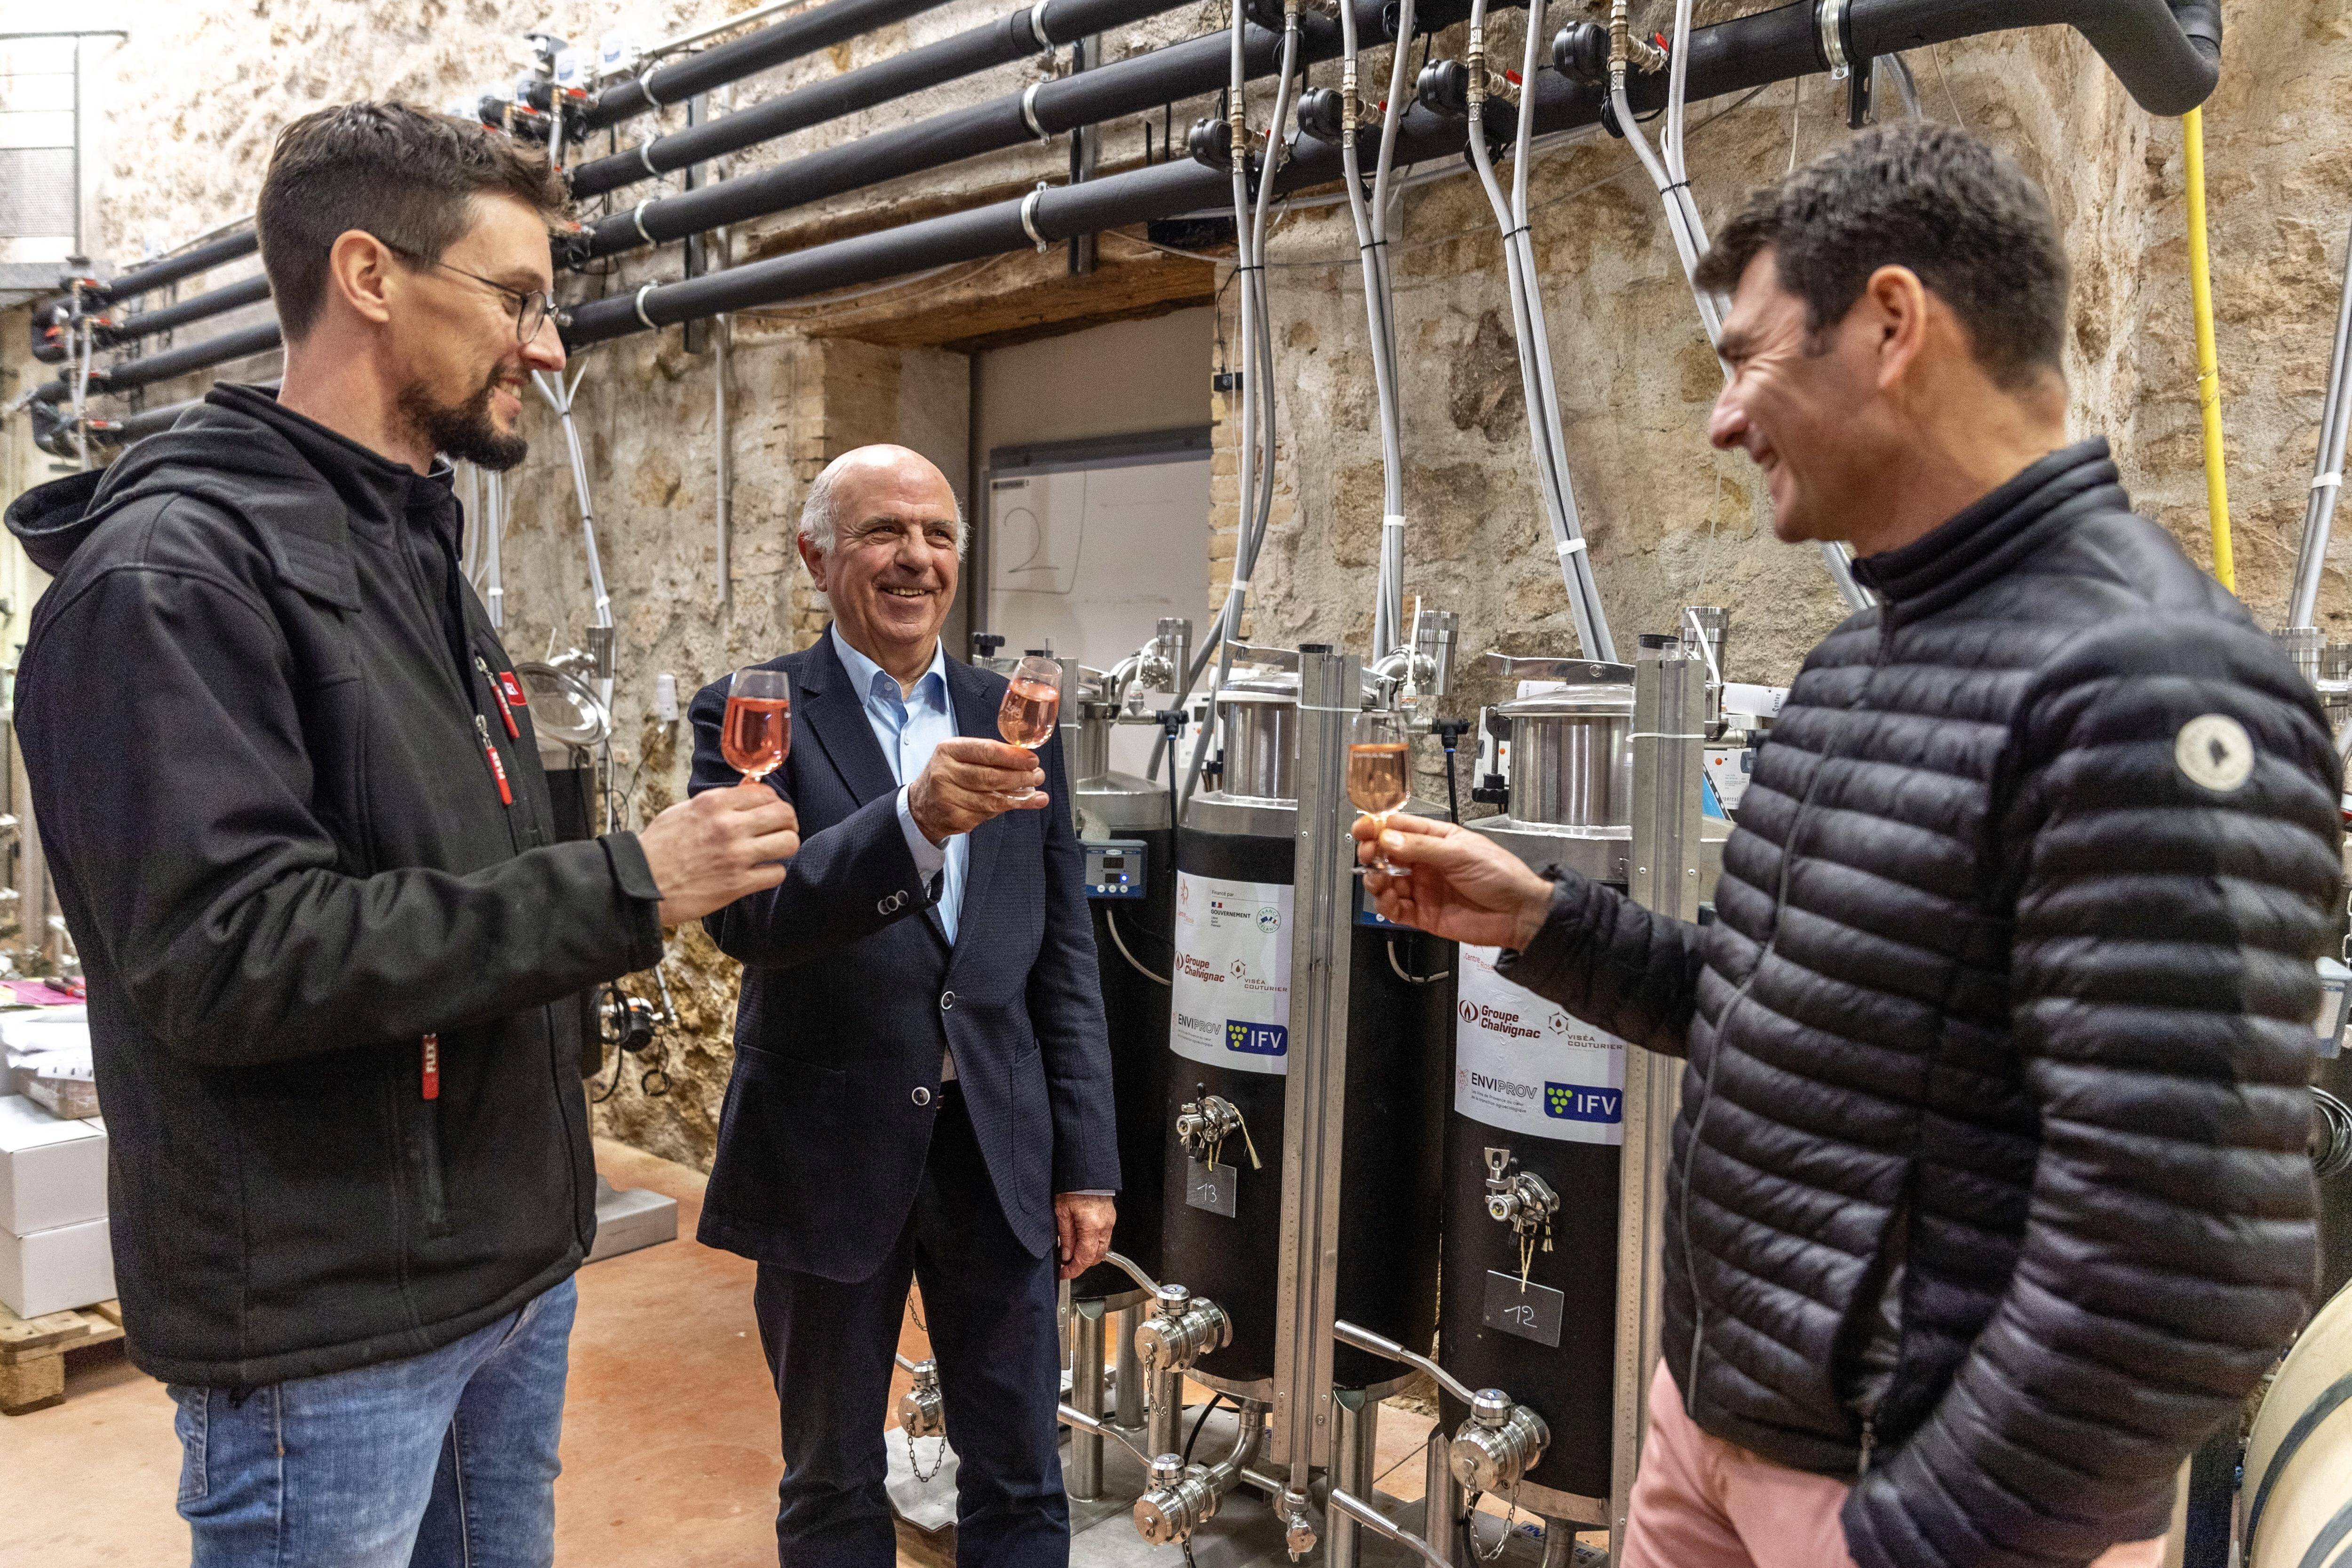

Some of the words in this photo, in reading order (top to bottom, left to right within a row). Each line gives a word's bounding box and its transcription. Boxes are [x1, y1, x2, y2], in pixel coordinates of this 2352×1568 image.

[1211, 909, 1251, 918] GOUVERNEMENT
[1258, 922, 1279, 931] RELANCE
[1185, 954, 1210, 969] Groupe
[1465, 953, 1480, 963] Centre
[1184, 964, 1225, 982] Chalvignac
[1481, 1005, 1519, 1023] Groupe
[1178, 1013, 1222, 1035] ENVIPROV
[1481, 1019, 1541, 1039] Chalvignac
[1251, 1029, 1282, 1048] IFV
[1568, 1041, 1622, 1050] COUTURIER
[1471, 1072, 1538, 1099] ENVIPROV
[1577, 1094, 1617, 1115] IFV
[1197, 1183, 1217, 1202] 13
[1504, 1305, 1537, 1328] 12
